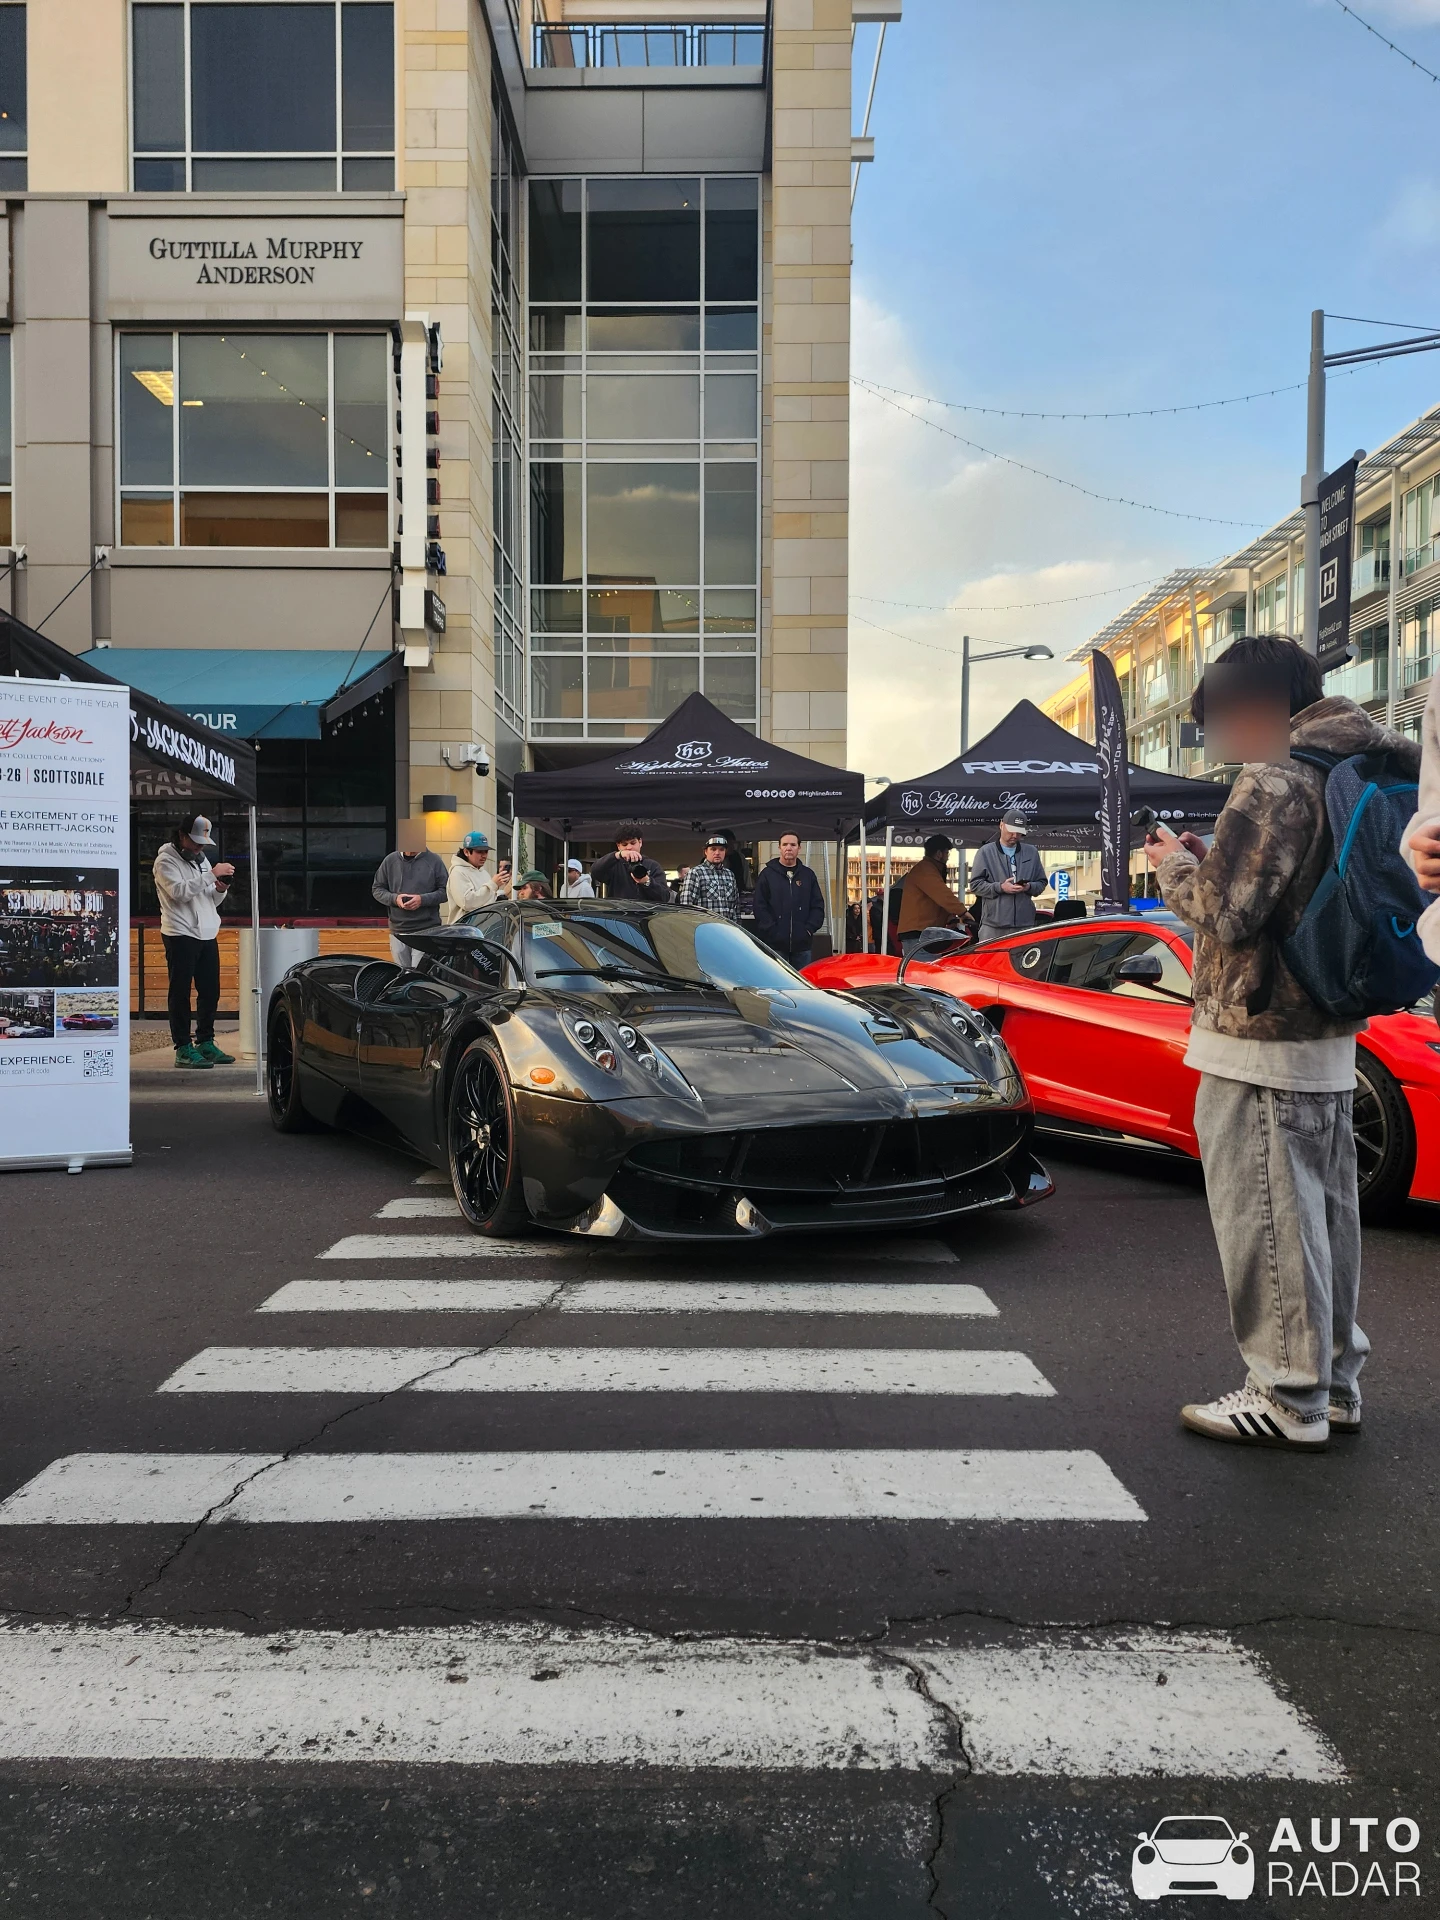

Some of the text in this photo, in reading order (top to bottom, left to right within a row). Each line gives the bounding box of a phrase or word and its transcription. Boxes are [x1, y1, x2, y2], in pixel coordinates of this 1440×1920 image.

[149, 237, 363, 259] GUTTILLA MURPHY
[196, 263, 315, 284] ANDERSON
[1321, 485, 1347, 514] WELCOME
[1320, 515, 1328, 531] TO
[1332, 517, 1349, 542] STREET
[28, 695, 57, 704] EVENT
[60, 697, 72, 705] OF
[76, 698, 93, 707] THE
[96, 700, 119, 709] YEAR
[187, 713, 238, 730] OUR
[962, 760, 1134, 774] RECAR
[33, 768, 105, 786] SCOTTSDALE
[926, 790, 1038, 816] Highline Autos
[10, 810, 78, 820] EXCITEMENT
[81, 813, 96, 821] OF
[98, 813, 119, 823] THE
[12, 822, 115, 834] BARRETT-JACKSON
[0, 1055, 75, 1066] EXPERIENCE.
